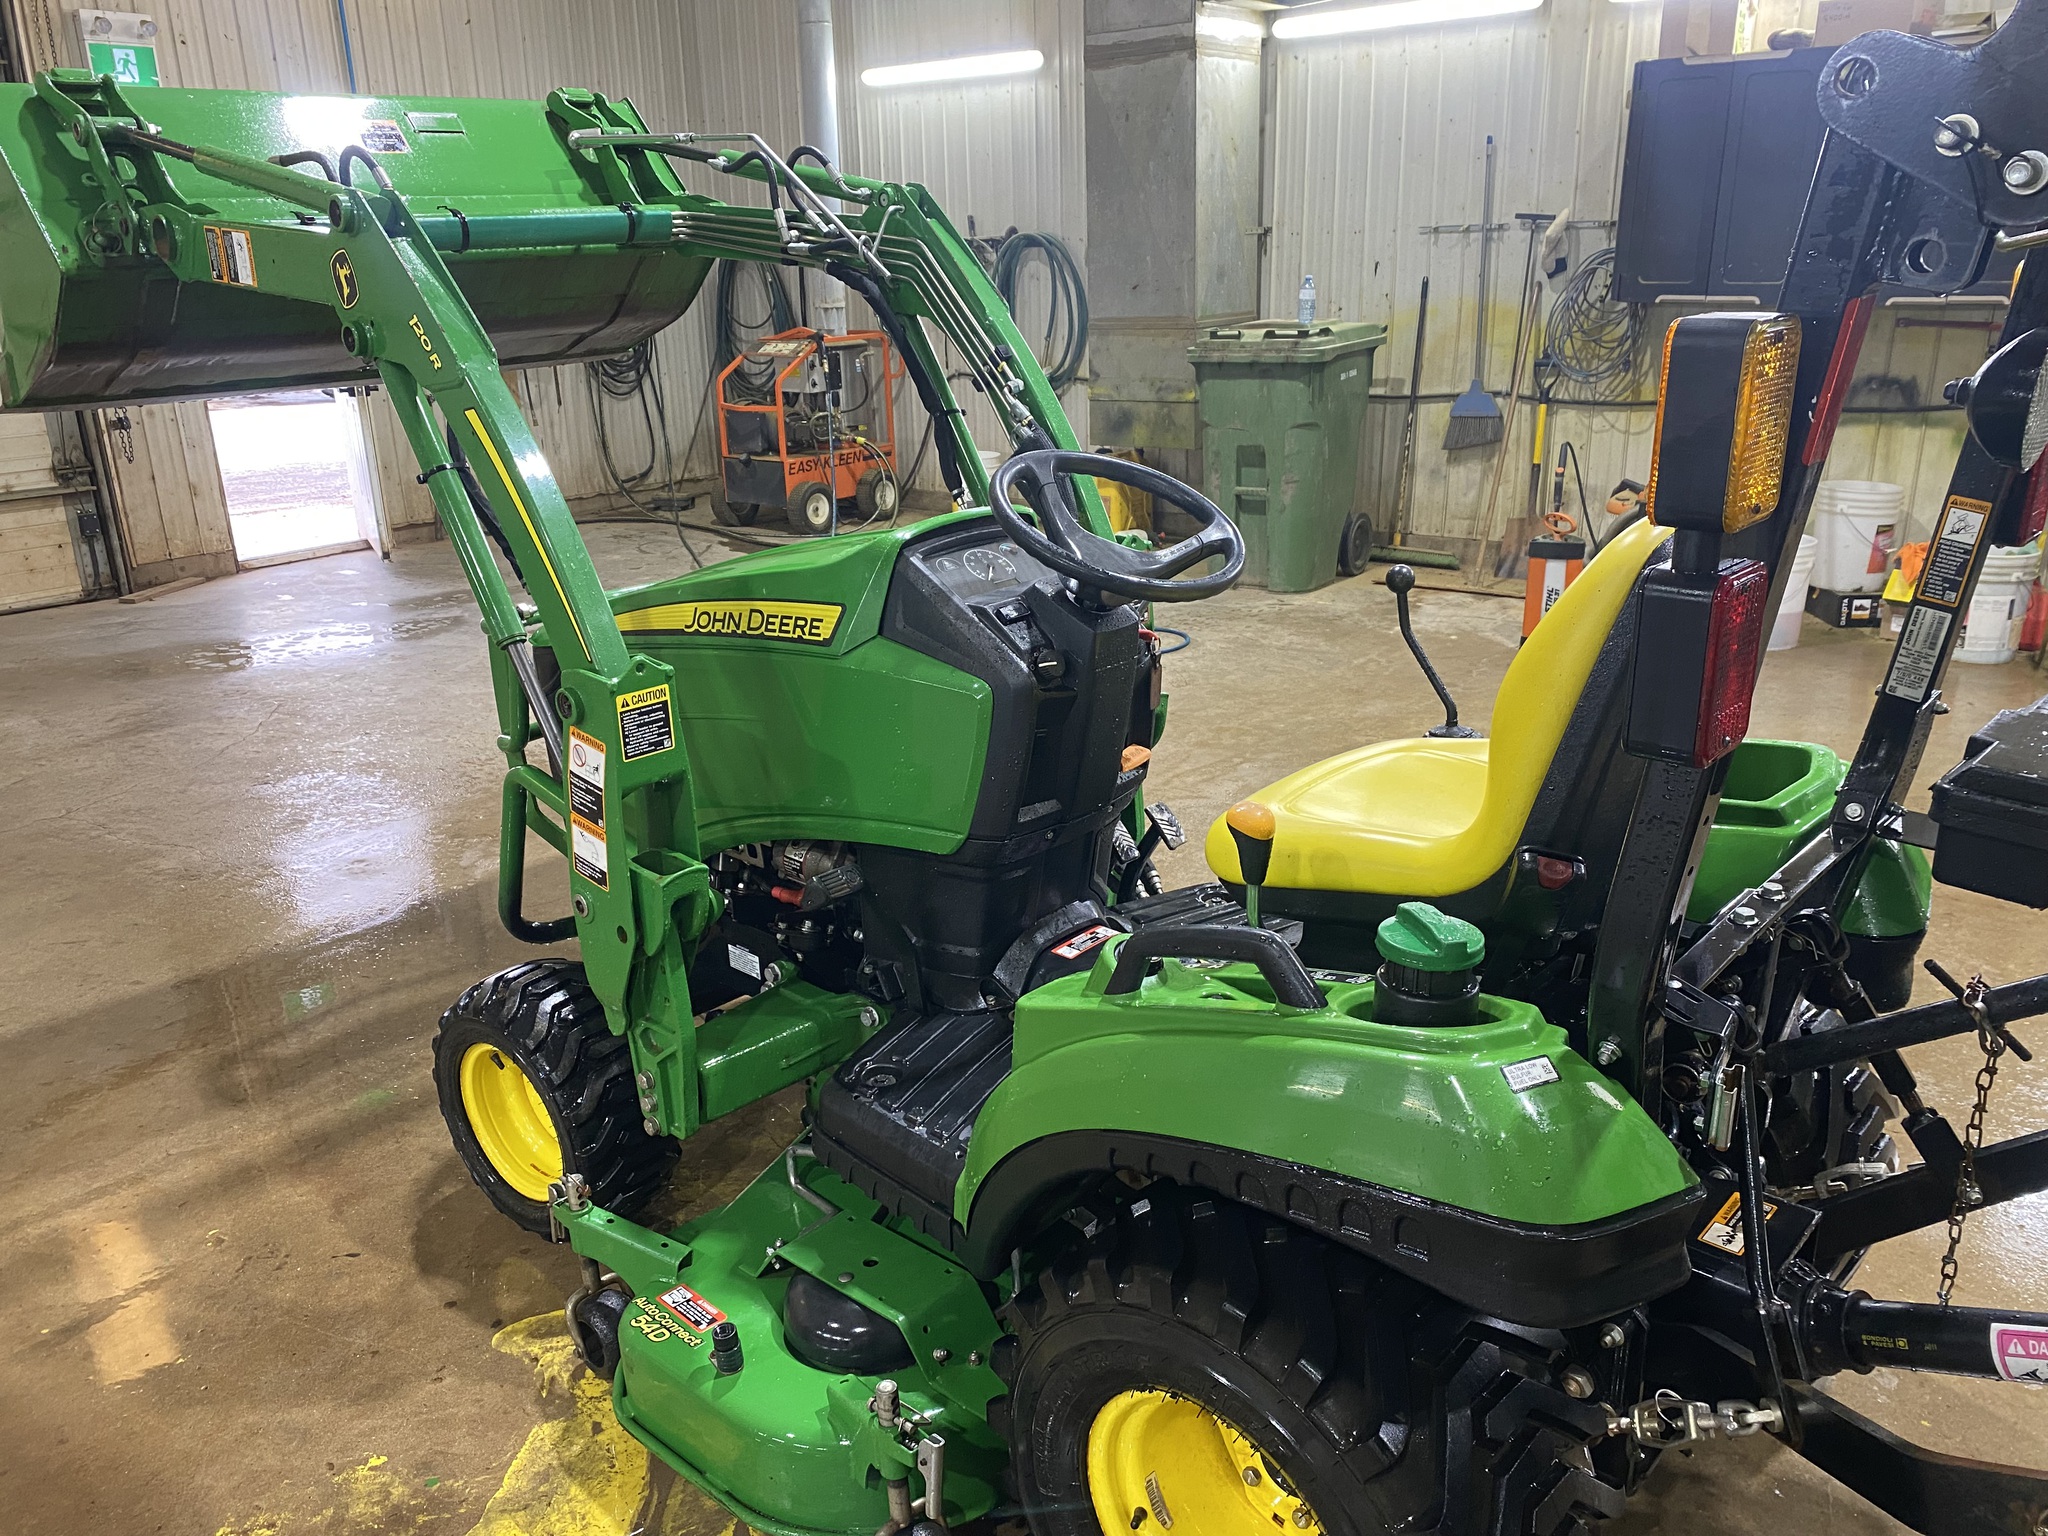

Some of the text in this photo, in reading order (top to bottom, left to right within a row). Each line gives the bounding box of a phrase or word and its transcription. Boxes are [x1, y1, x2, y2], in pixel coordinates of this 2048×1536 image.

[788, 450, 863, 476] EASY KLEEN
[1958, 499, 1989, 513] WARNING
[1545, 587, 1554, 613] STIHL
[684, 607, 824, 639] JOHN DEERE
[1905, 608, 1923, 646] JOHN DEERE
[631, 687, 667, 706] CAUTION
[575, 730, 605, 752] WARNING
[577, 818, 605, 842] WARNING
[1507, 1062, 1538, 1075] ULTRA LOW
[1513, 1074, 1542, 1087] FUEL ONLY
[630, 1313, 671, 1343] 54D
[632, 1296, 704, 1347] AutoConnect
[1861, 1334, 1893, 1343] BONDIOLI
[1870, 1340, 1895, 1349] PAVESI
